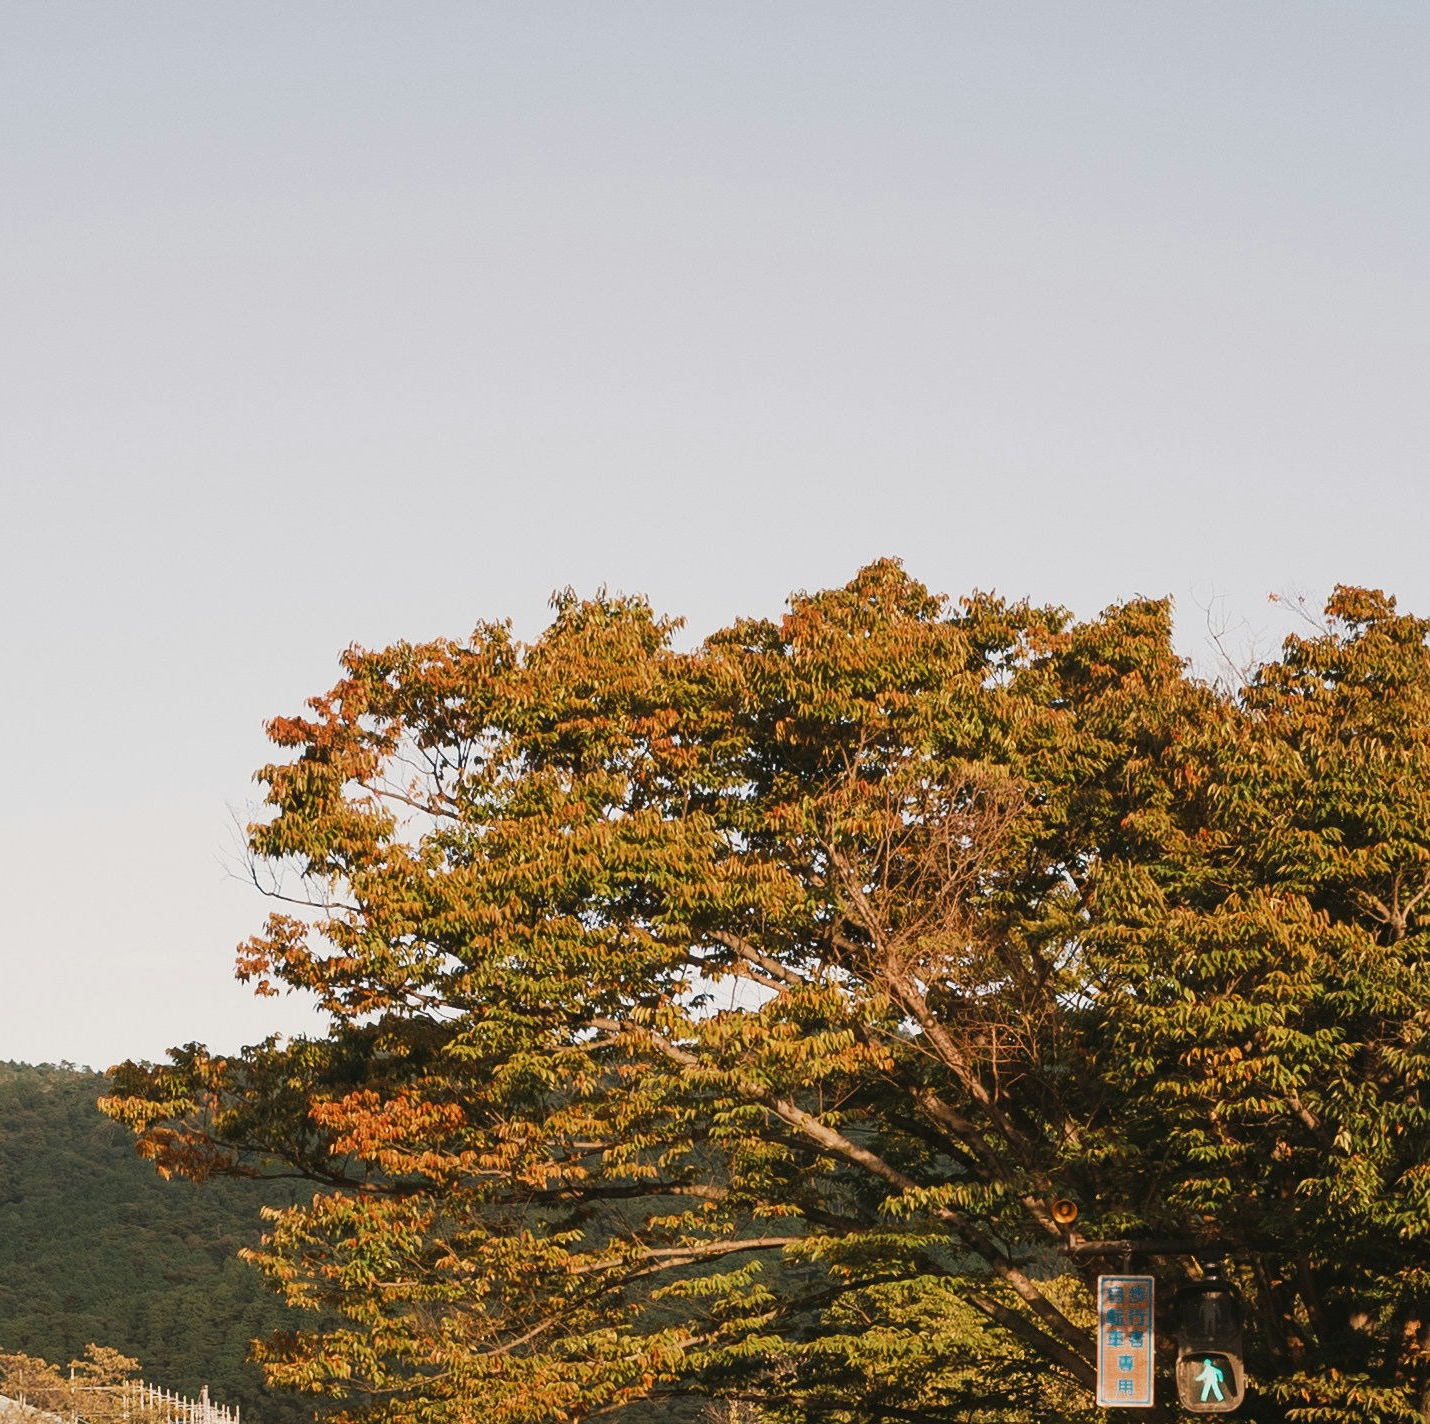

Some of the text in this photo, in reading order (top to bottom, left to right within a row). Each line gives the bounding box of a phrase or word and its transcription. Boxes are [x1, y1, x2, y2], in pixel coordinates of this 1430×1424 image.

[1107, 1285, 1124, 1348] 自転車
[1128, 1285, 1145, 1349] 歩行者
[1117, 1354, 1134, 1396] 専用
